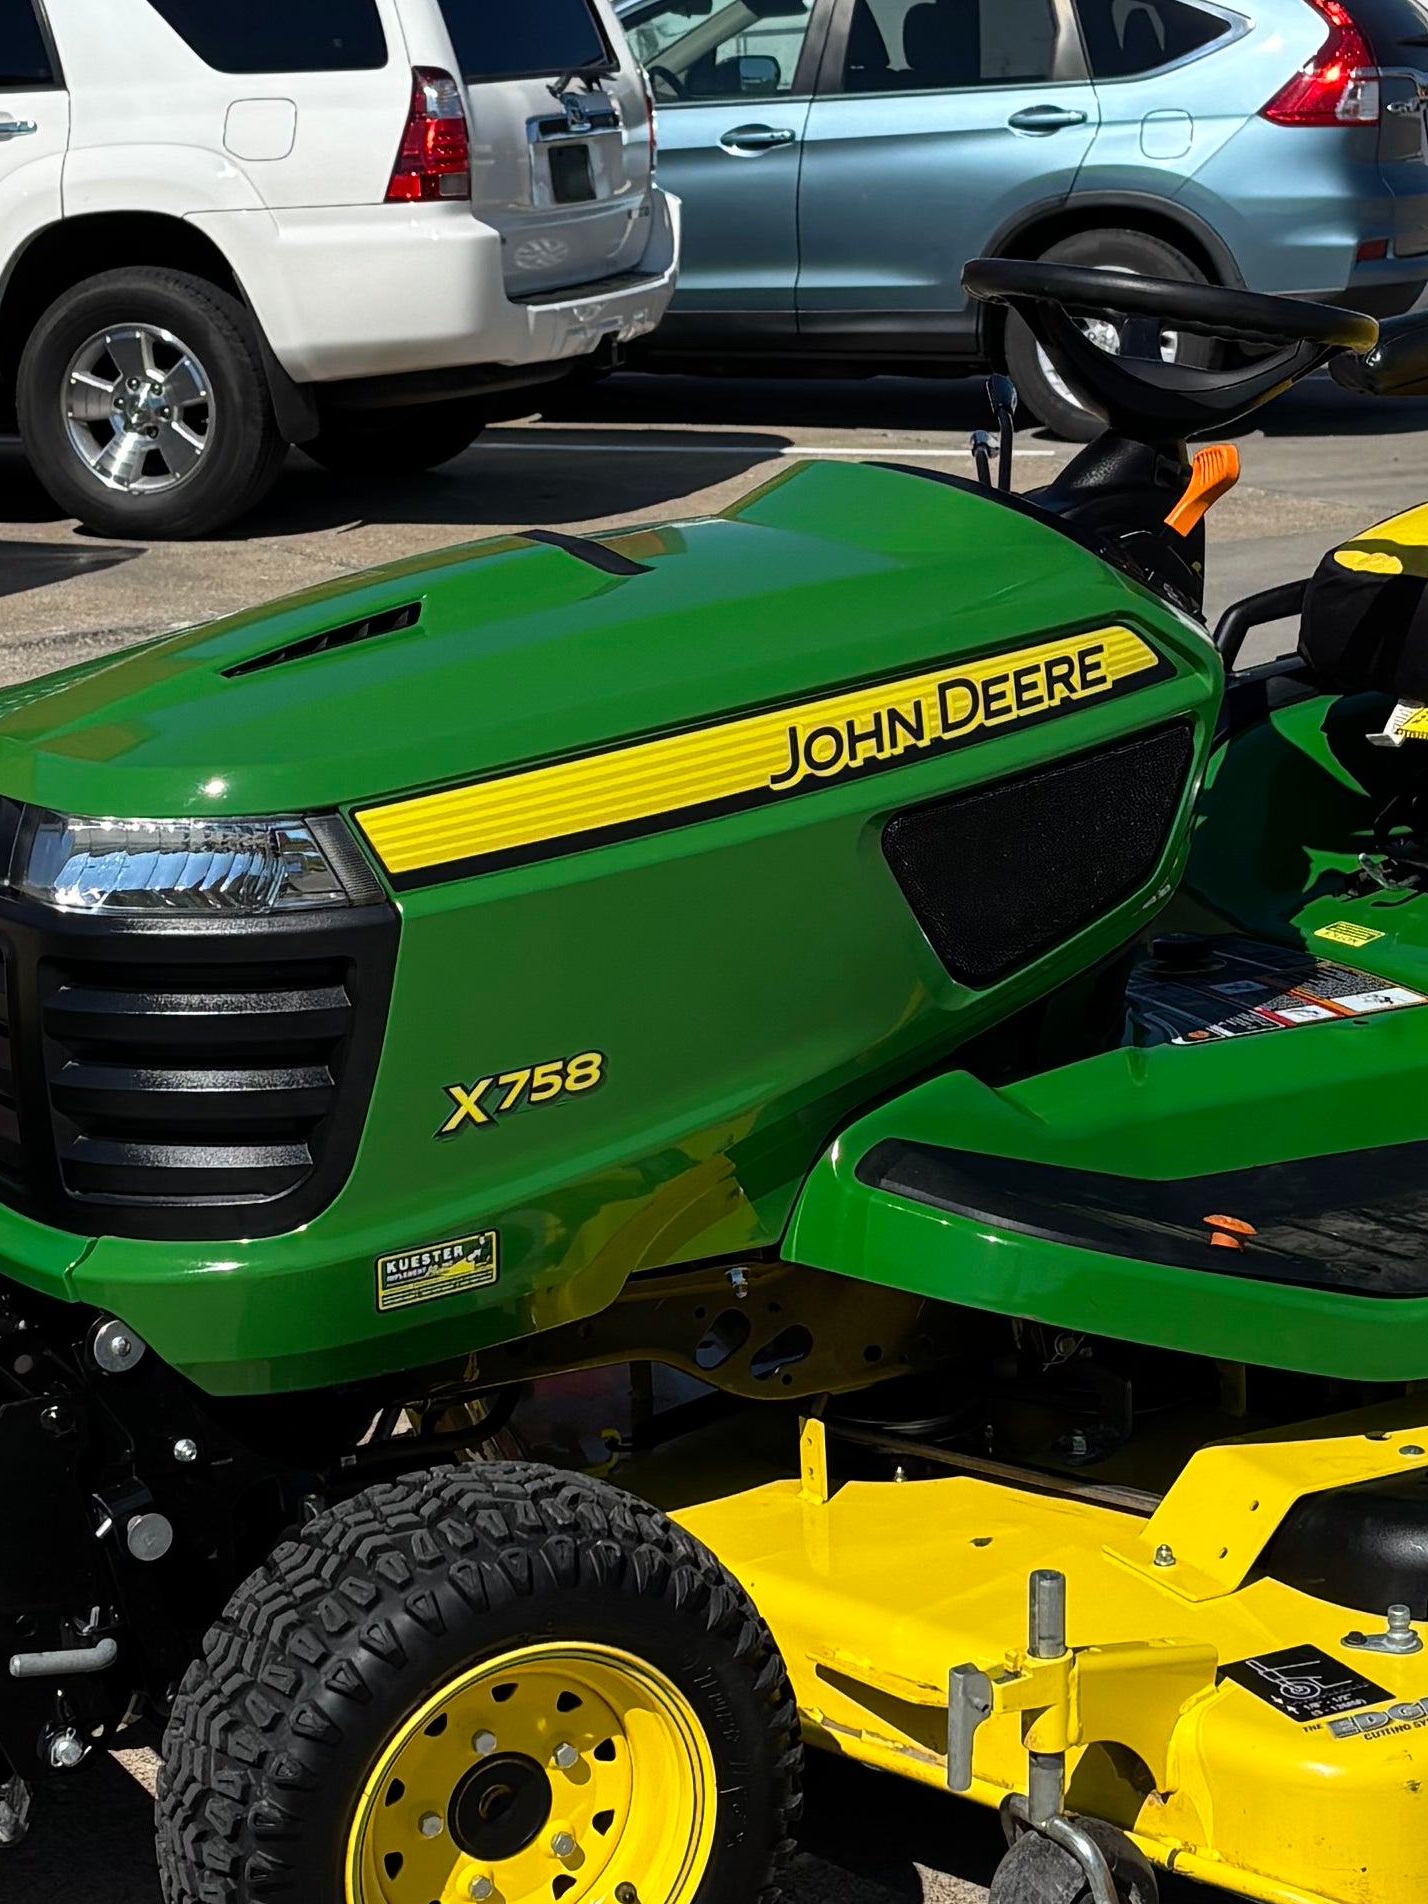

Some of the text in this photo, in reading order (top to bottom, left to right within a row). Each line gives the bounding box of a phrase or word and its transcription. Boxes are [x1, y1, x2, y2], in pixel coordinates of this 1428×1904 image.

[770, 644, 1110, 785] JOHN DEERE
[440, 1052, 603, 1133] X758
[385, 1245, 464, 1274] KUESTER
